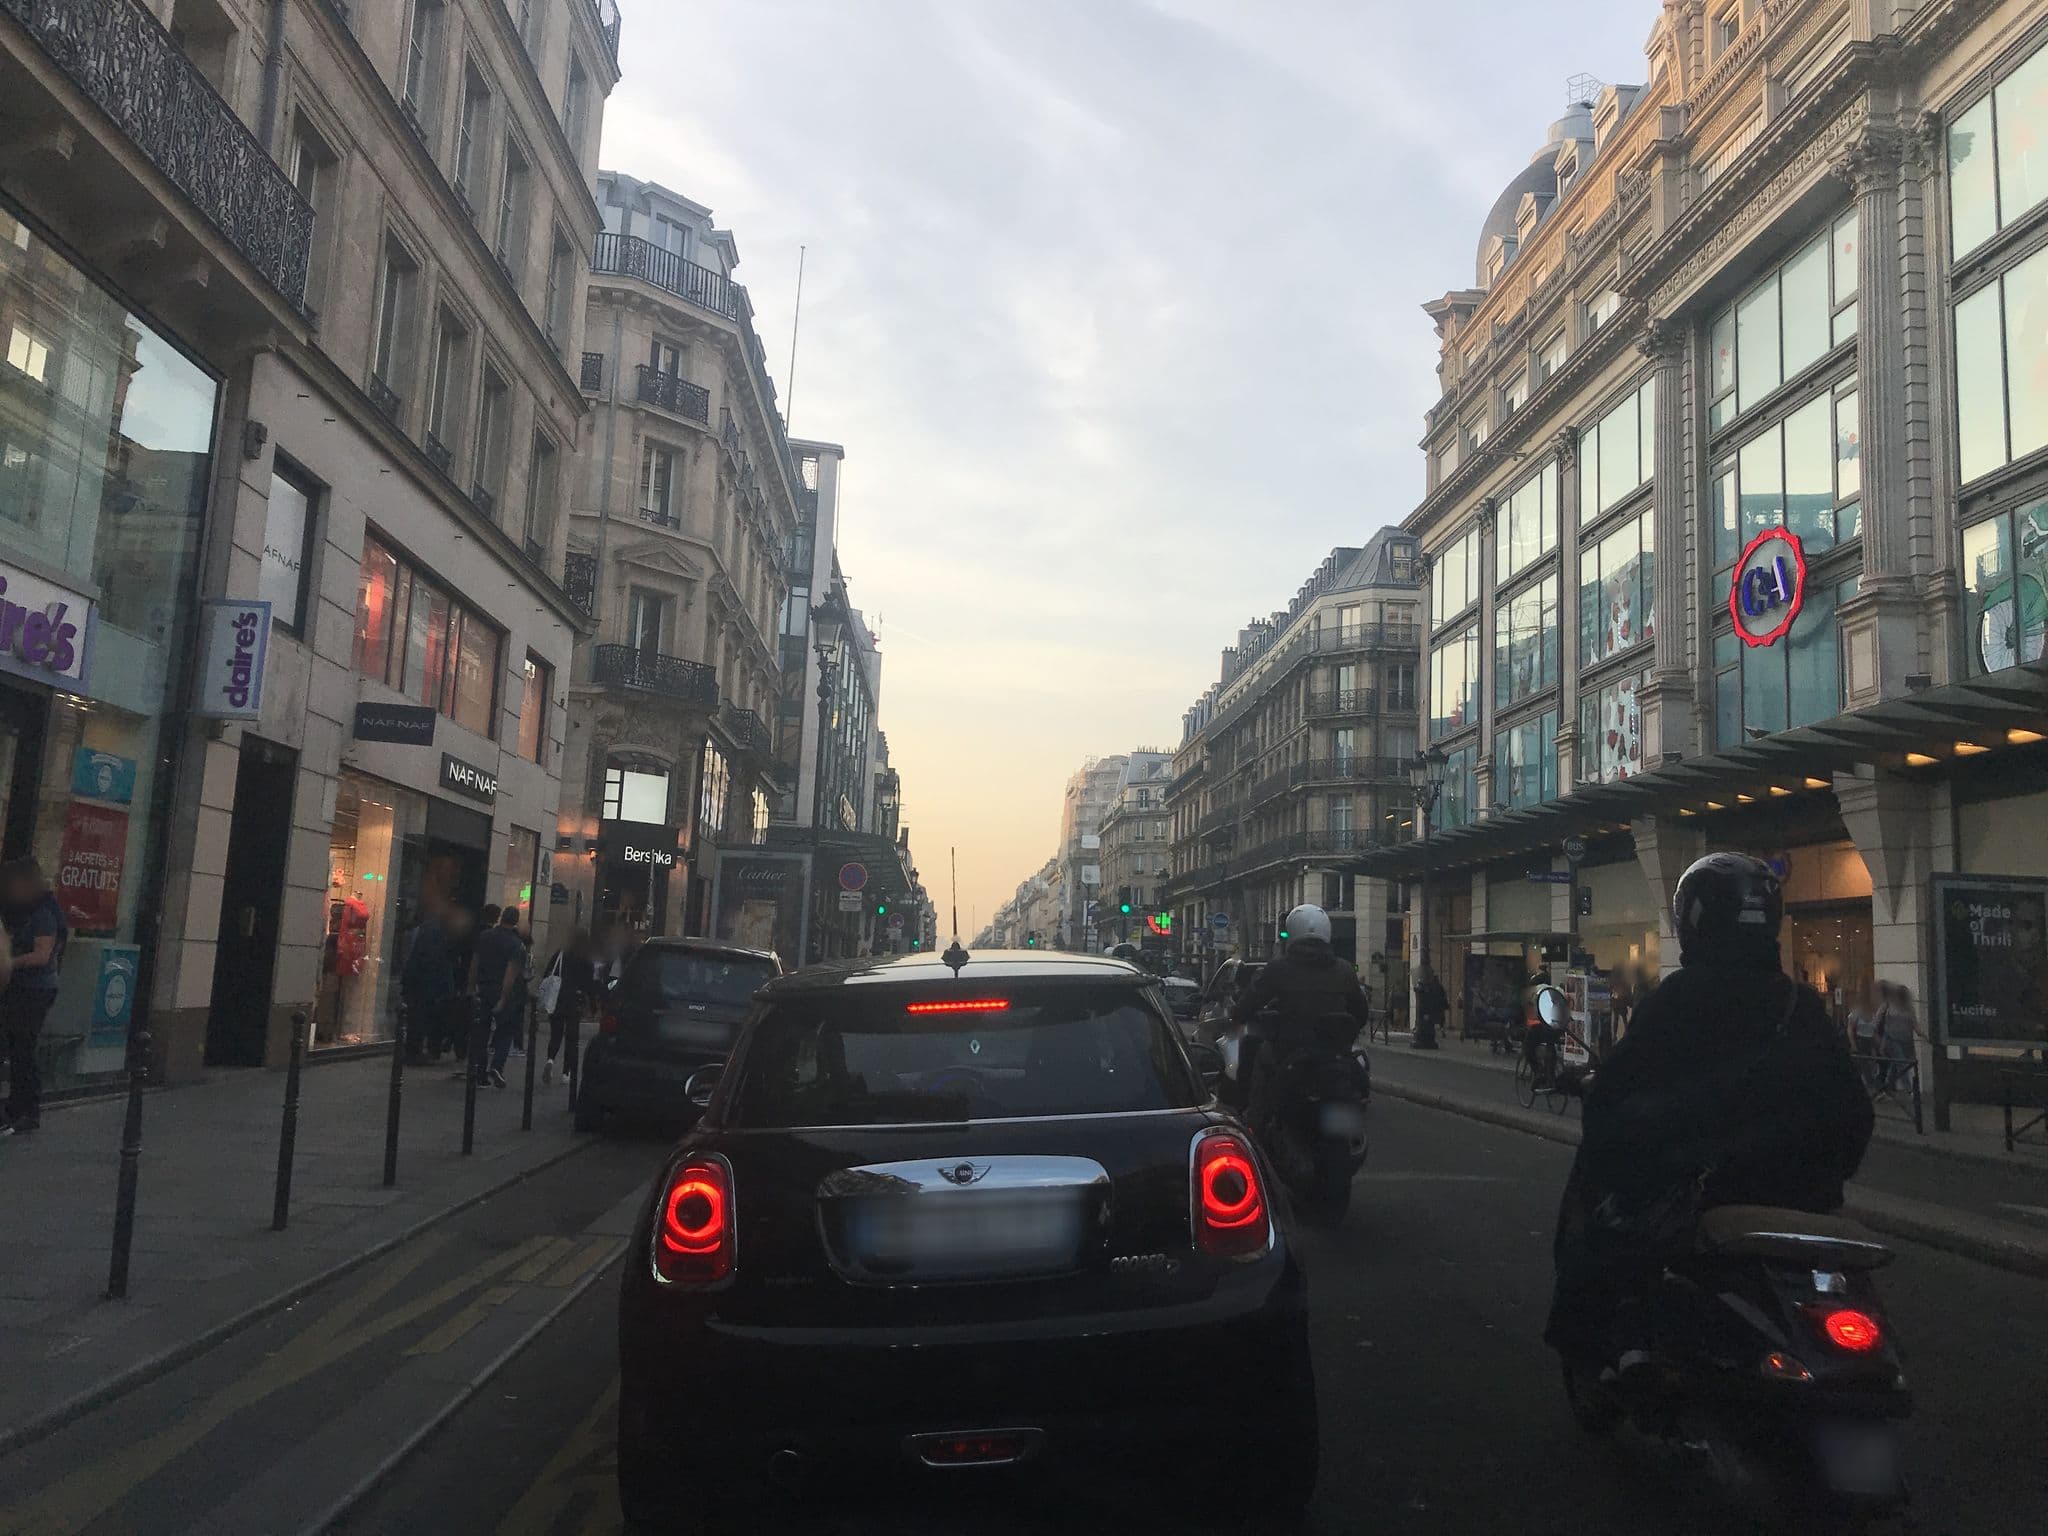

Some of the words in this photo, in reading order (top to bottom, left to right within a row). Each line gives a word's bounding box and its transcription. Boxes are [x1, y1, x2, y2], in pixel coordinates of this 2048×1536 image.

[1742, 556, 1790, 617] C&A
[362, 717, 396, 728] NAF
[397, 720, 432, 731] NAF
[449, 762, 474, 787] NAF
[475, 774, 498, 796] NAF
[624, 846, 672, 865] Bershka
[61, 866, 120, 891] GRATUITS
[737, 866, 789, 881] Cartier
[1968, 904, 2011, 919] Made
[1969, 919, 1985, 931] of
[1971, 932, 2012, 947] Thrill
[1952, 1003, 1998, 1017] Lucifer
